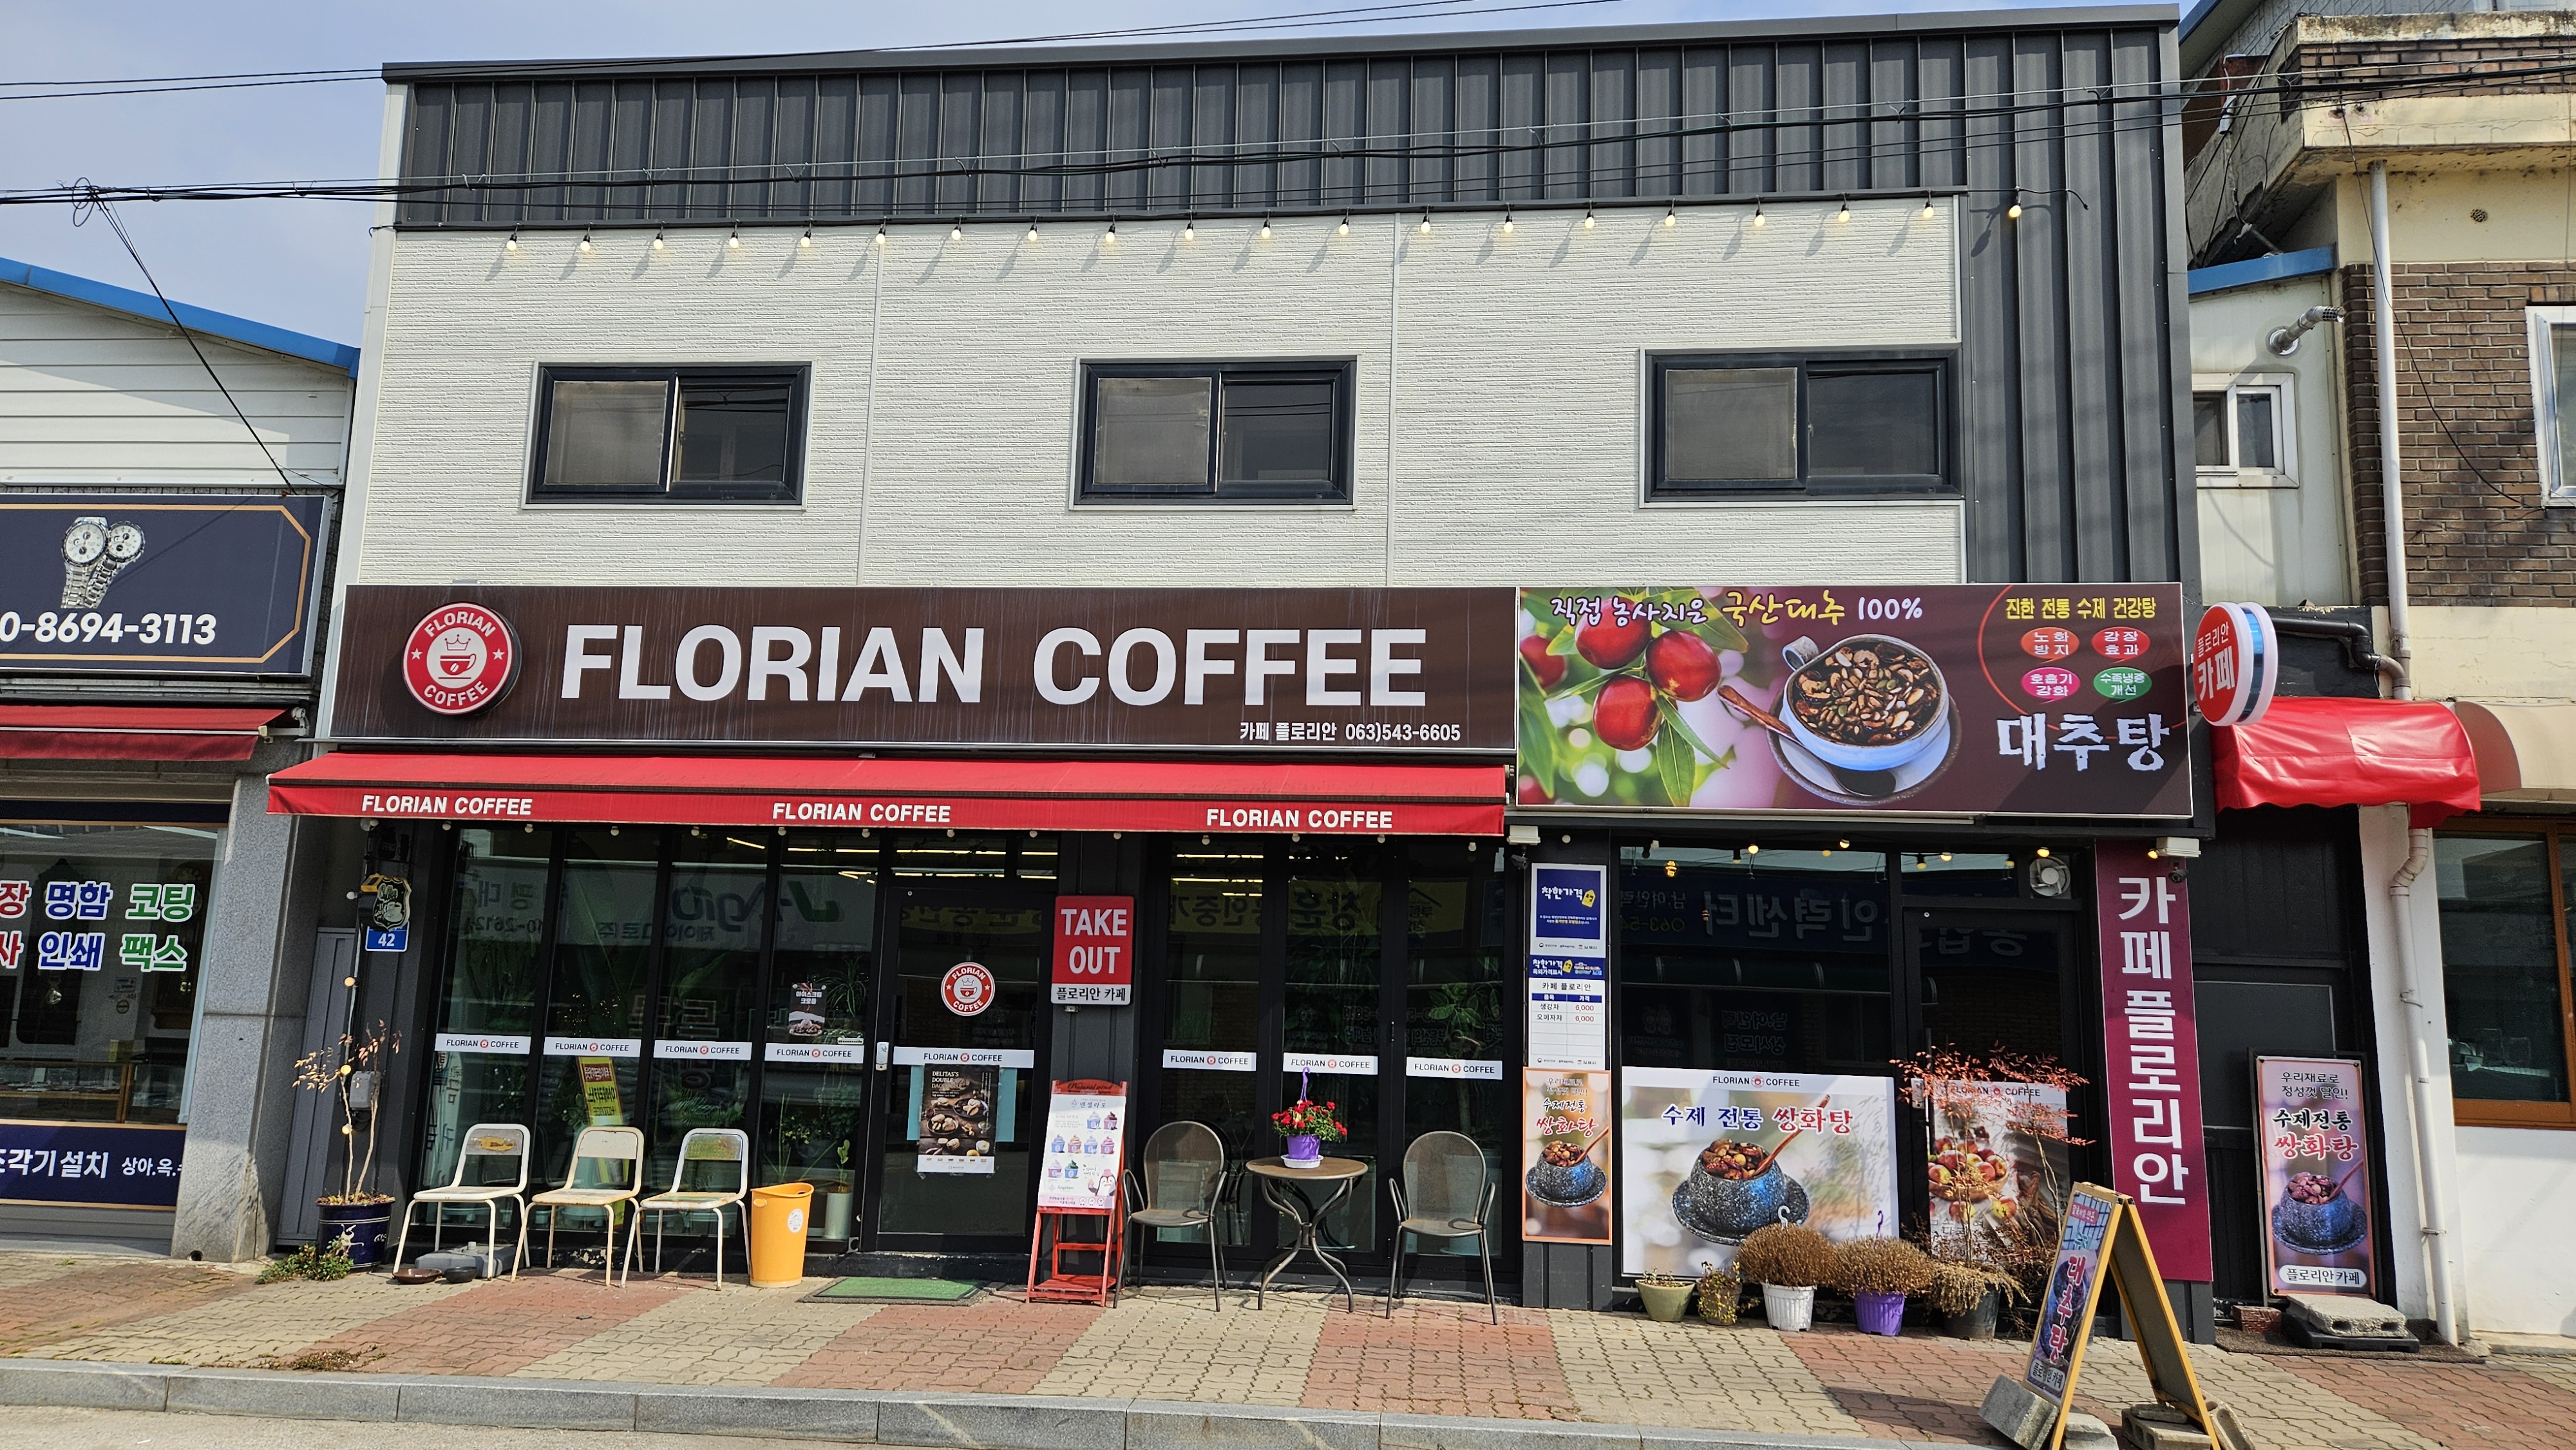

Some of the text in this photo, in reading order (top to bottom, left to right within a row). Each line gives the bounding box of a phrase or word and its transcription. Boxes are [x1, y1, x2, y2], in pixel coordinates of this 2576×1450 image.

[1550, 589, 1923, 628] 직접 농사지은 국산대추 100%
[2005, 597, 2157, 619] 진한 전통 수제 건강탕
[424, 610, 496, 637] FLORIAN
[2197, 621, 2230, 658] 플로리안
[560, 625, 1426, 706] FLORIAN COFFEE
[2197, 646, 2237, 701] 카페
[2030, 673, 2073, 685] 호흡기
[2100, 672, 2145, 684] 수족냉증
[424, 680, 488, 706] COFFEE
[2036, 685, 2069, 697] 강화
[2111, 684, 2137, 696] 개선
[1240, 721, 1461, 743] 카페 플로리안 063)543-6605
[1997, 712, 2170, 772] 대추탕
[362, 795, 533, 816] FLORIAN COFFEE
[773, 802, 951, 824] FLORIAN COFFEE
[1206, 809, 1393, 829] FLORIAN COFFEE
[46, 881, 113, 919] 명함
[126, 883, 195, 921] 코팅
[1541, 886, 1583, 901] 착한가격
[1061, 909, 1127, 936] TAKE
[378, 933, 395, 946] 42
[38, 931, 105, 970] 인쇄
[120, 934, 187, 971] 팩스
[1068, 946, 1121, 974] OUT
[951, 966, 986, 980] FLORIAN
[1533, 959, 1563, 968] 착한가격
[1056, 987, 1126, 1001] 플로리안 카페
[952, 999, 984, 1012] COFFEE
[446, 1039, 478, 1048] FLORIAN
[555, 1042, 588, 1051] FLORIAN
[972, 1053, 1003, 1062] COFFEE
[1170, 1055, 1204, 1064] FLORIAN
[1291, 1059, 1370, 1069] FLORIAN COFFEE
[1463, 1065, 1495, 1073] COFFEE
[2281, 1071, 2340, 1084] 우리재료로
[1713, 1076, 1800, 1087] FLORIAN COFFEE
[1953, 1087, 2041, 1097] LOAN COFFEE
[2282, 1085, 2349, 1100] 정성껏 달인!
[1536, 1115, 1598, 1137] 쌍화탕
[1662, 1103, 1854, 1136] 수제 전통 쌍화탕
[2272, 1108, 2353, 1131] 수제전통
[2274, 1131, 2358, 1161] 쌍화탕
[122, 1157, 182, 1177] 상아.옥.
[2049, 1255, 2087, 1365] 대추탕
